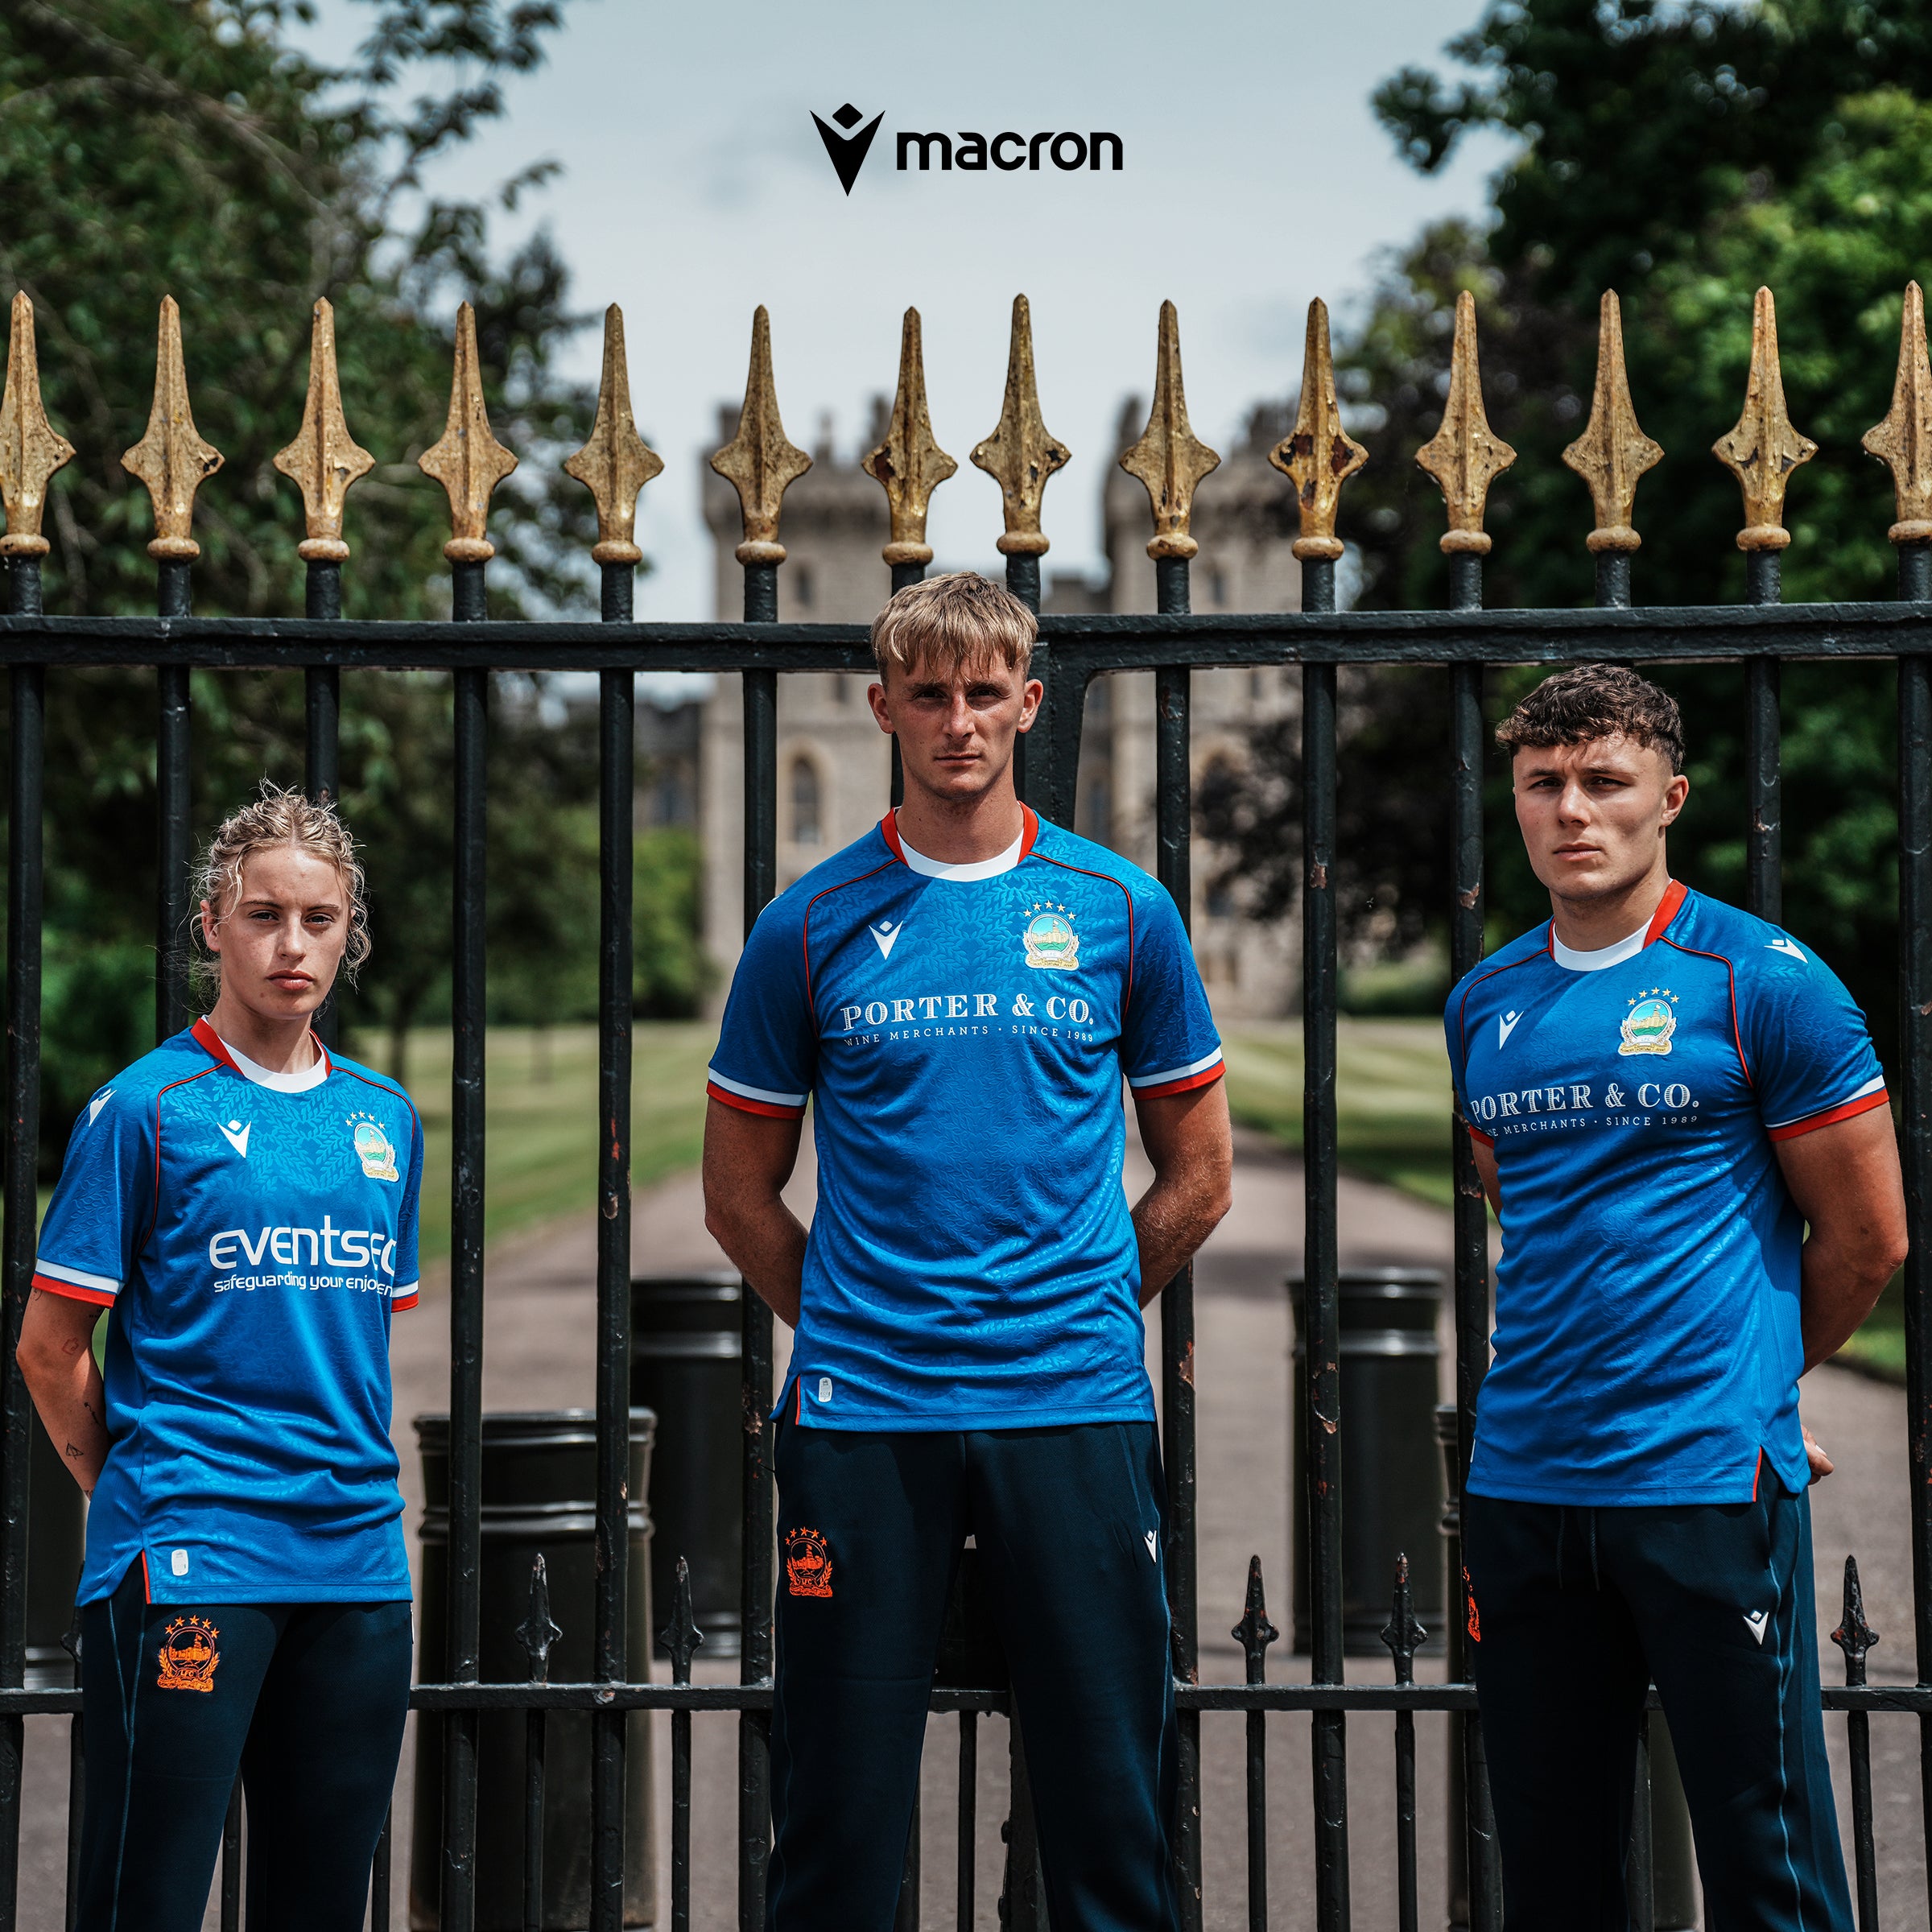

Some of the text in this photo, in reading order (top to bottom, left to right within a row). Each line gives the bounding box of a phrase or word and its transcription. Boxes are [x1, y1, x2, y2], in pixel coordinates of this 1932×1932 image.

[840, 993, 1094, 1031] PORTER & CO.
[844, 1025, 1093, 1046] WINE MERCHANTS SINCE 1989
[1470, 1083, 1699, 1124] PORTER & CO.
[1503, 1117, 1586, 1135] MERCHANTS
[1606, 1116, 1651, 1126] SINCE
[1662, 1115, 1698, 1125] 1989
[213, 1271, 307, 1293] safeguarding
[309, 1274, 344, 1291] your
